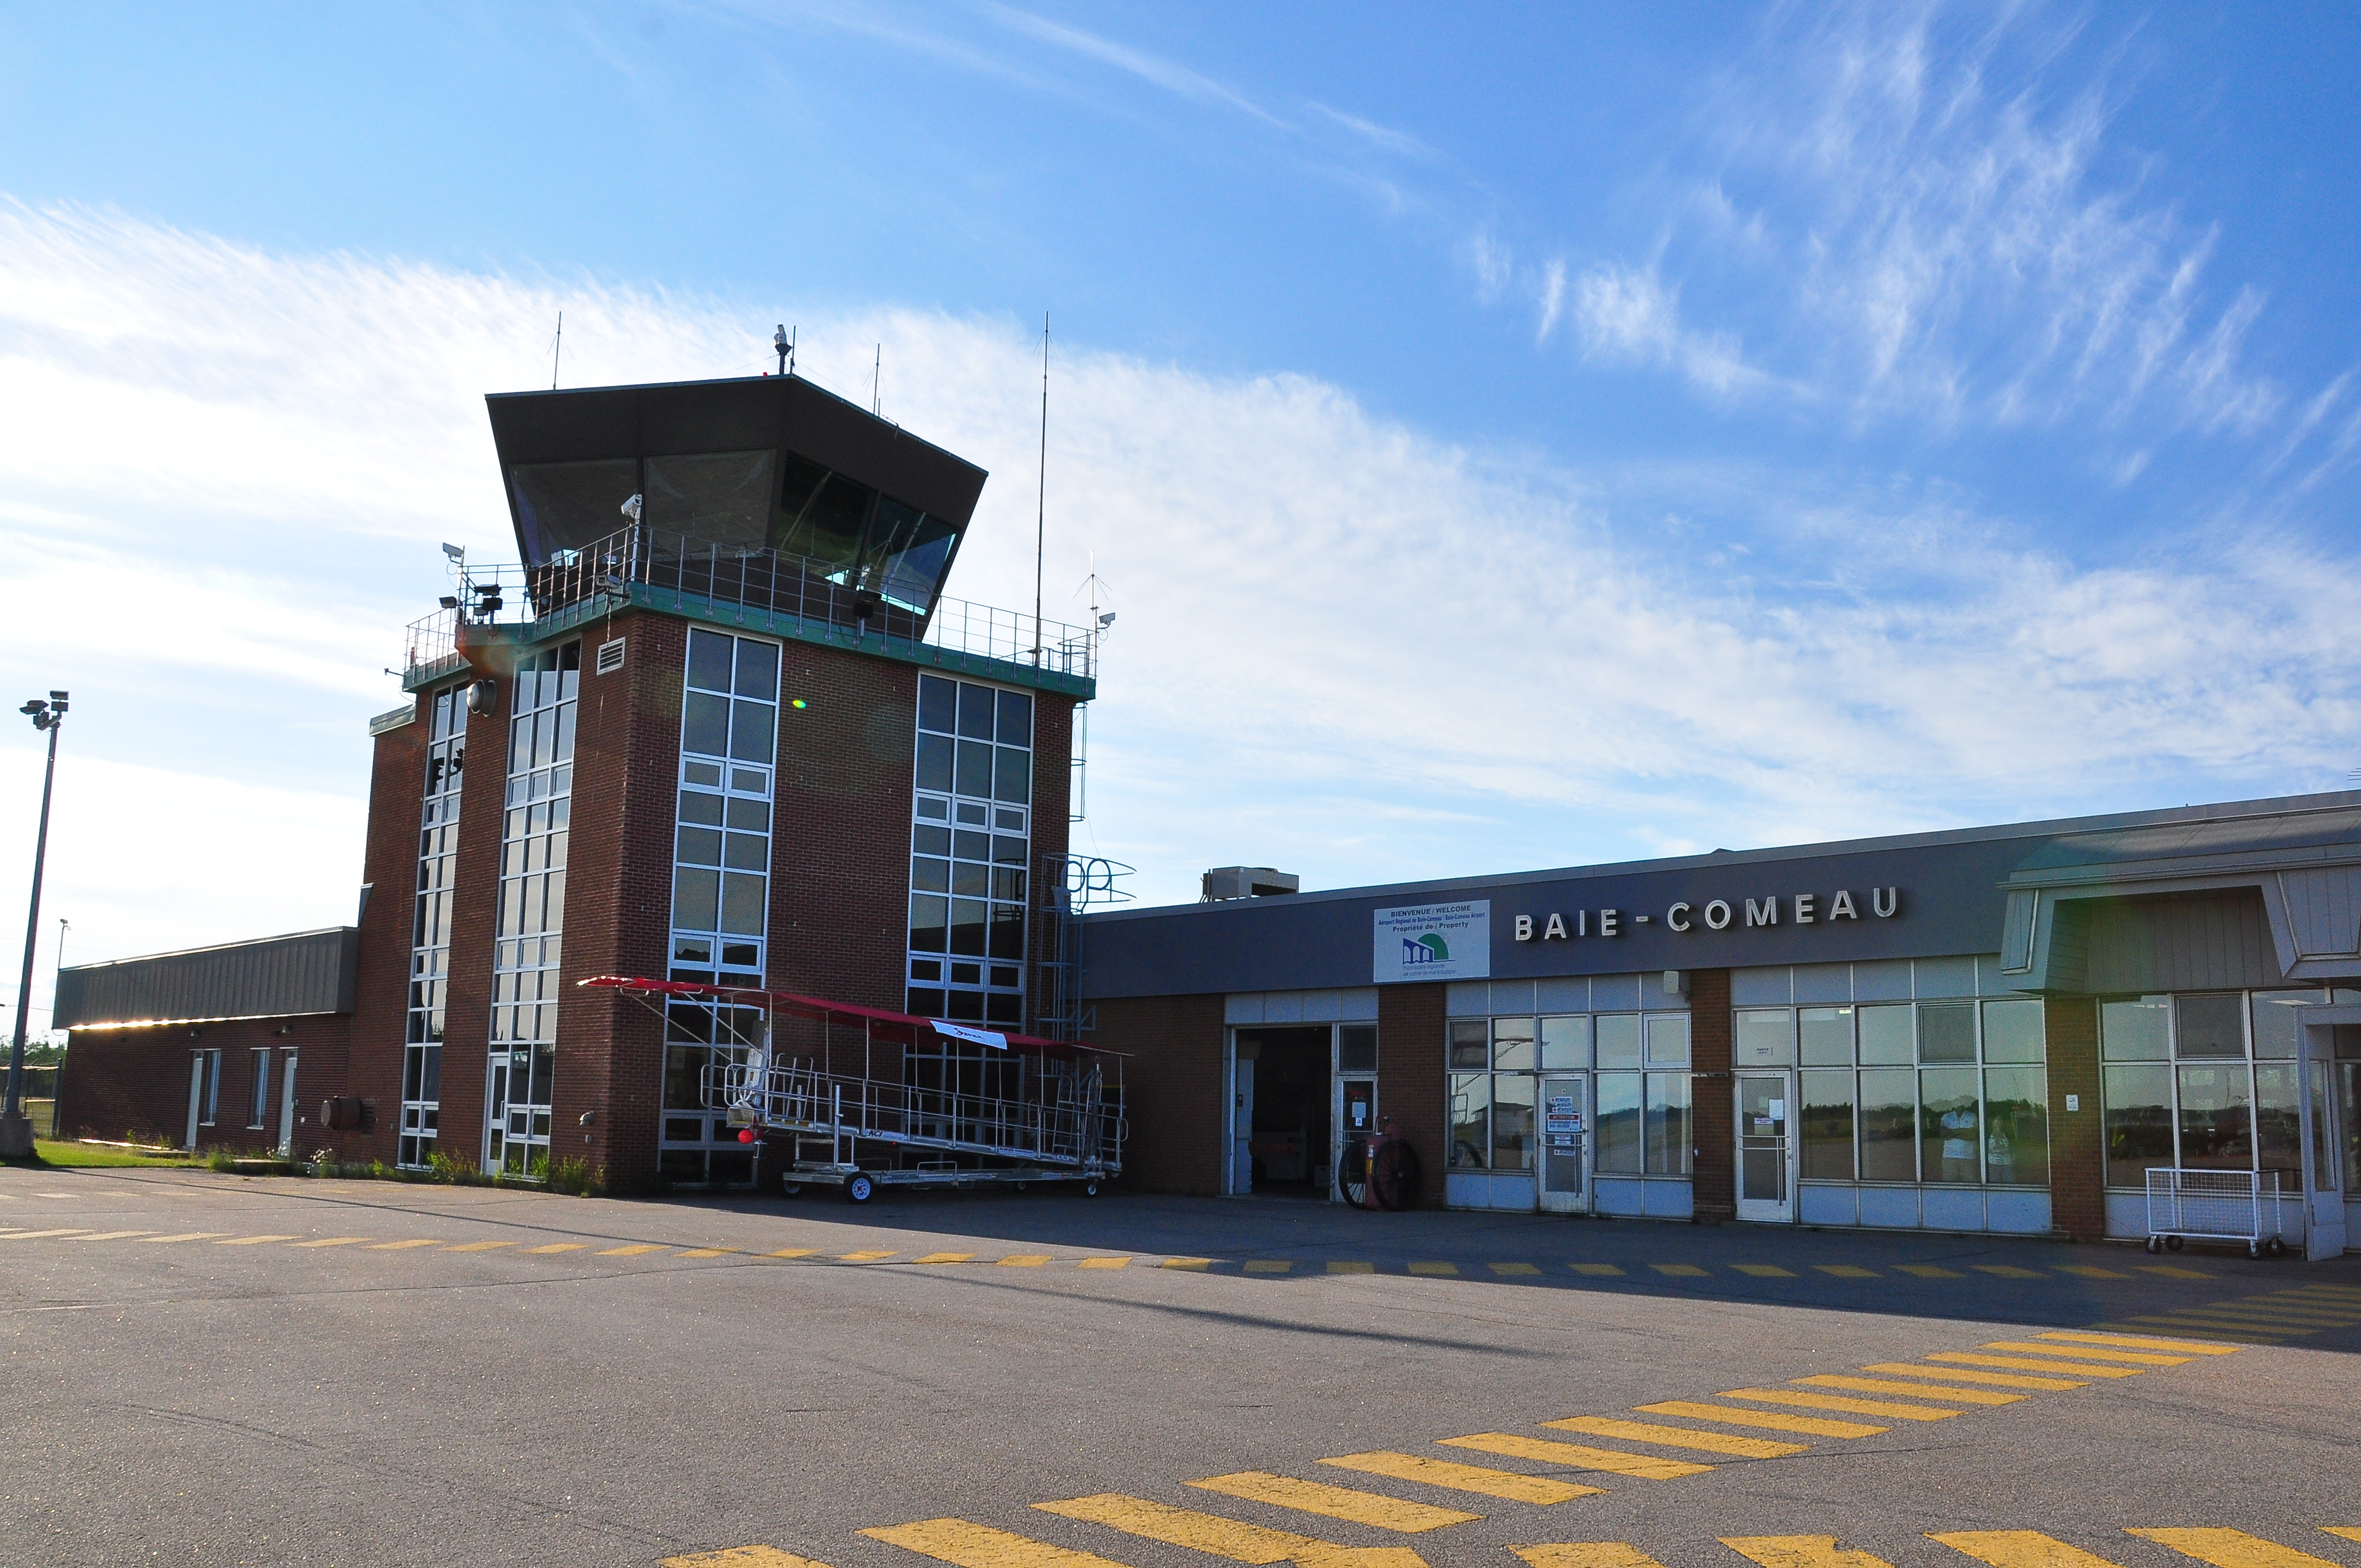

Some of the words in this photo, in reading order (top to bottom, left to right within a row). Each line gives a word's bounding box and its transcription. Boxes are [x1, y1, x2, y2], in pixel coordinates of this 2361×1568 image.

[1390, 908, 1430, 918] BIENVENUE
[1436, 905, 1471, 913] WELCOME
[1392, 924, 1423, 932] Propriété
[1439, 921, 1469, 929] Property
